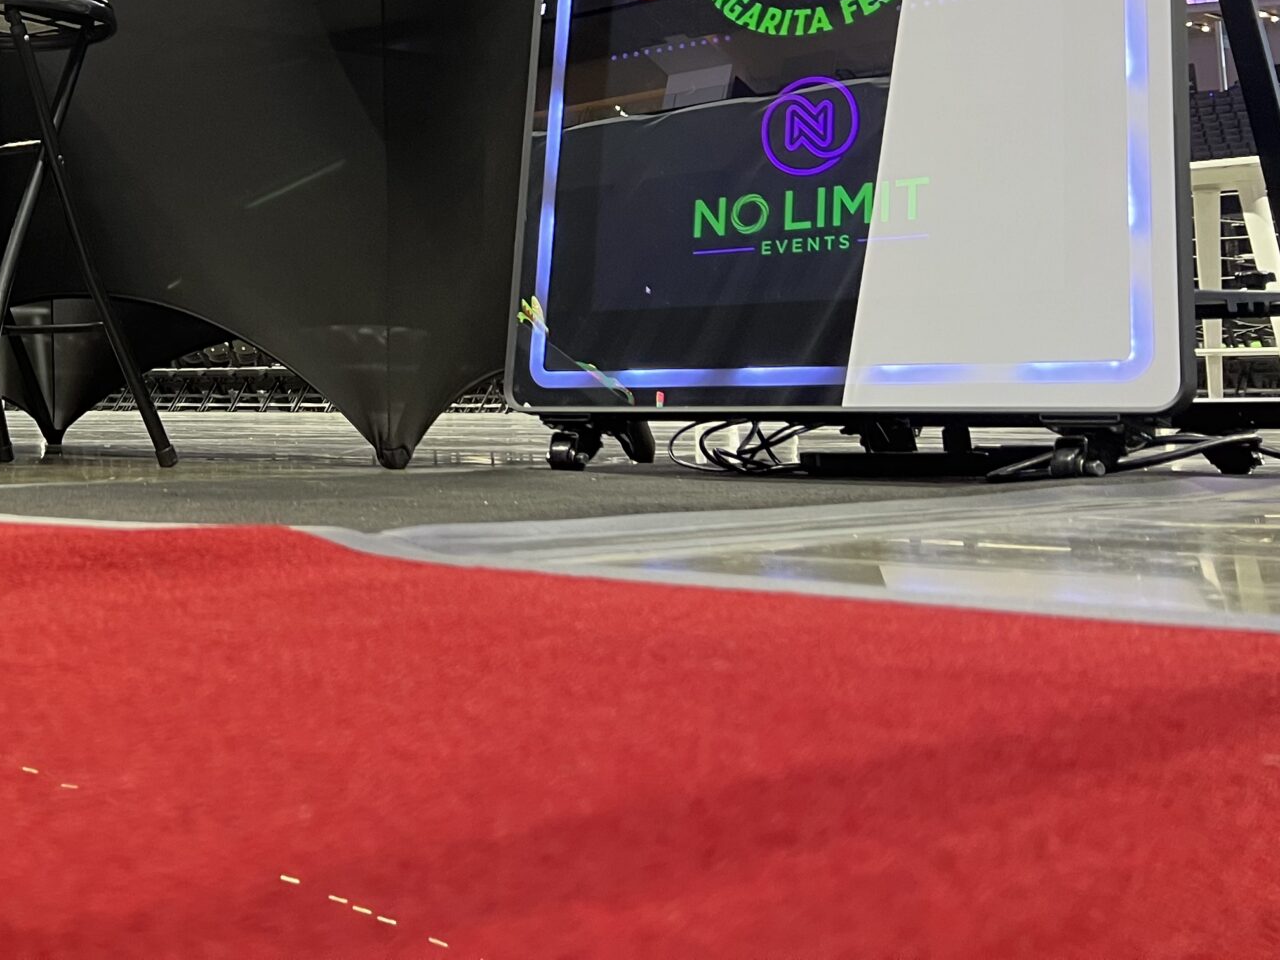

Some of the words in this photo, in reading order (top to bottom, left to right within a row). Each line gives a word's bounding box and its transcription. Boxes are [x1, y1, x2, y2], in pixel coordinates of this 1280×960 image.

[693, 193, 770, 238] NO
[784, 176, 931, 231] LIMIT
[760, 235, 851, 256] EVENTS
